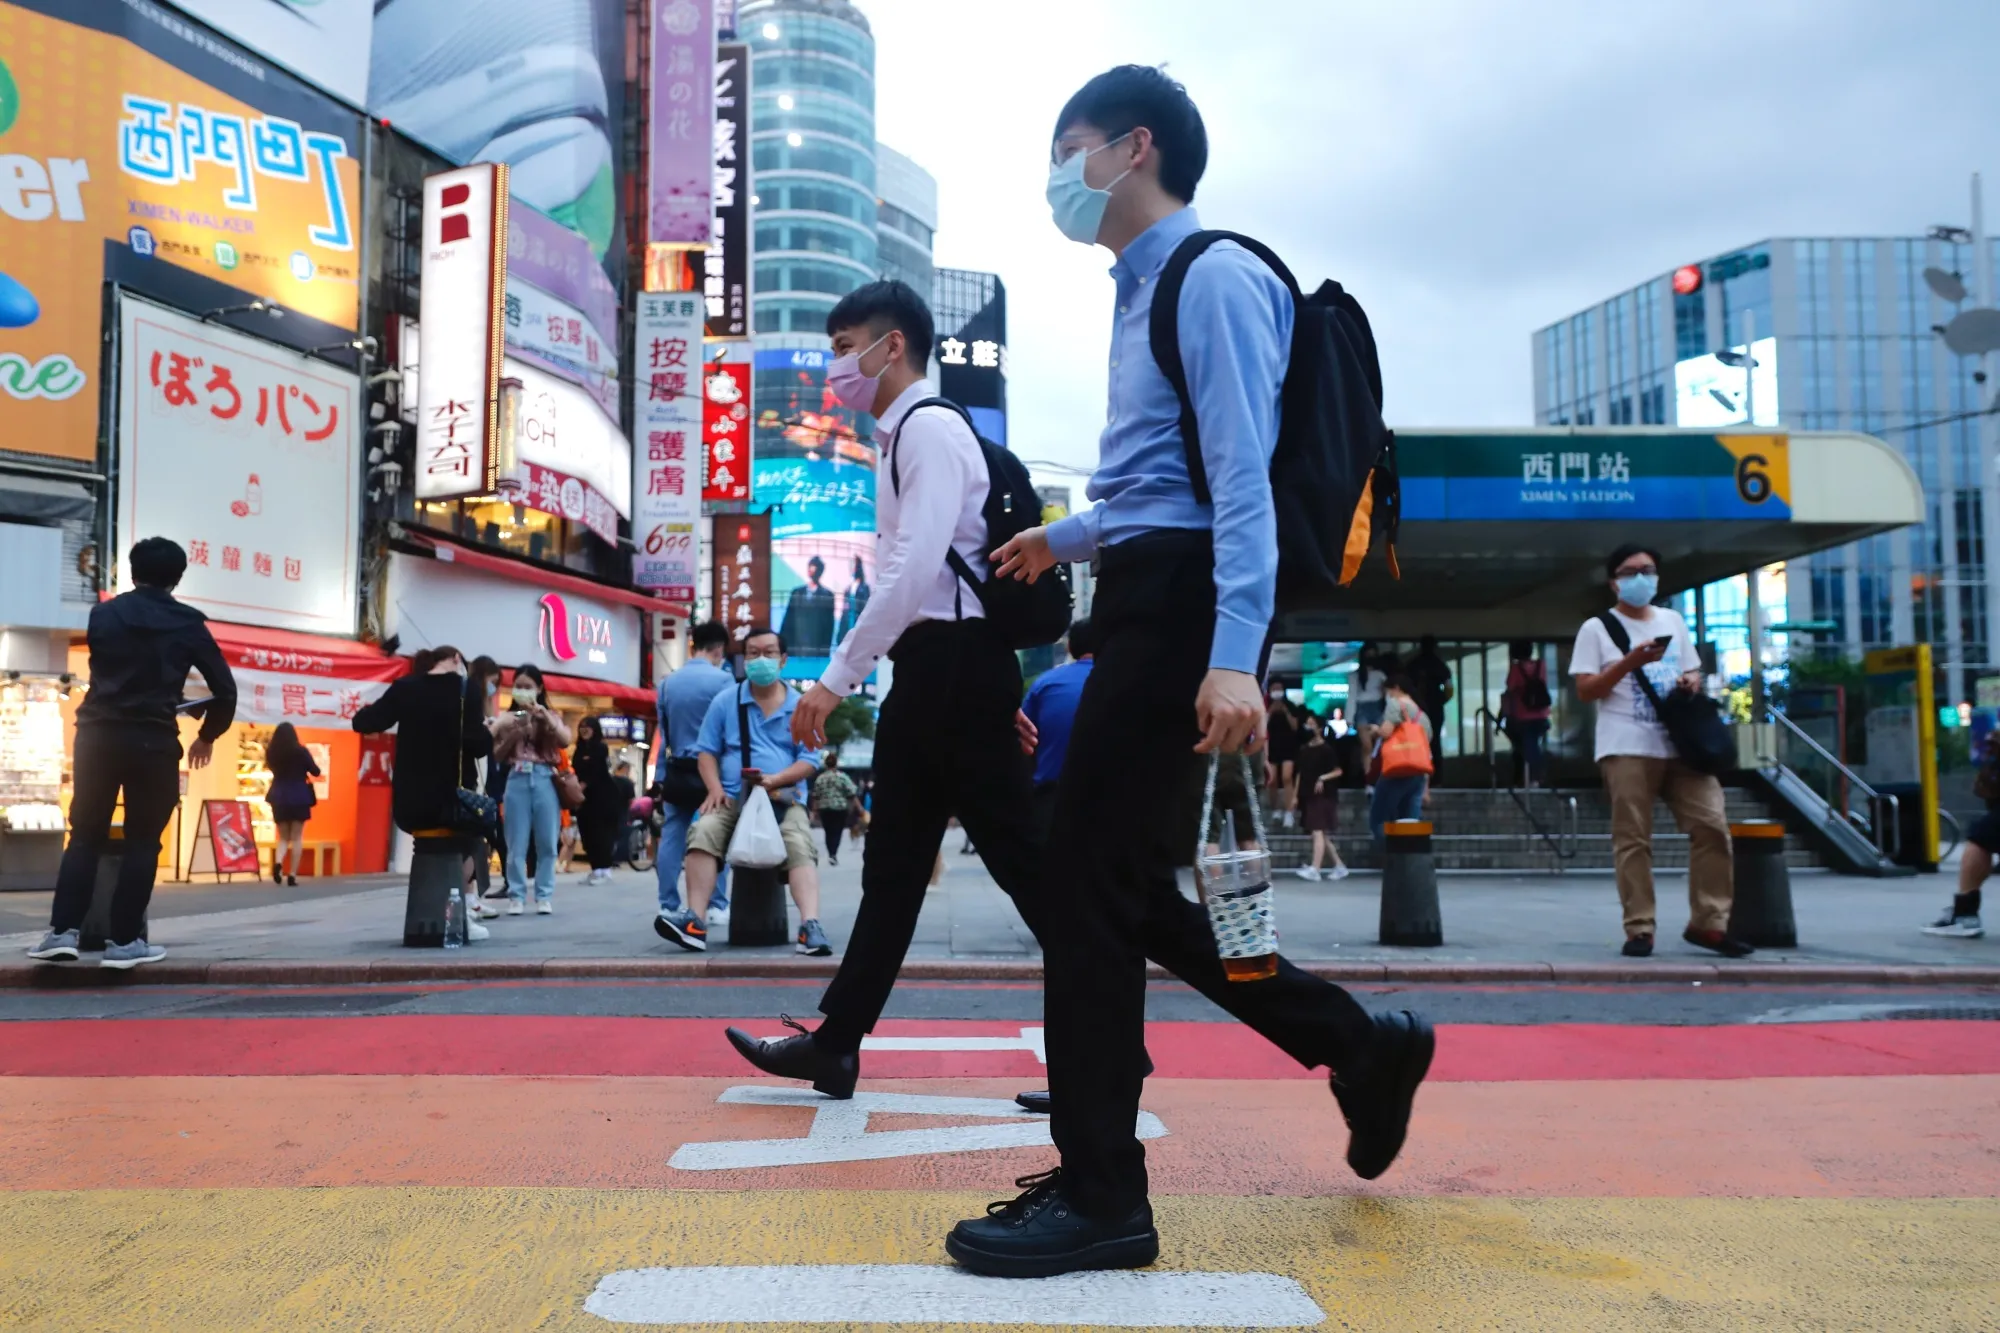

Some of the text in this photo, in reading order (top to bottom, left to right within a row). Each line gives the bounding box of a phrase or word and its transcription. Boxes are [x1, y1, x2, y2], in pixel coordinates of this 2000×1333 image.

[119, 93, 354, 251] 西門町
[1520, 451, 1631, 484] 西門站
[1738, 453, 1772, 505] 6
[1572, 489, 1635, 502] STATION
